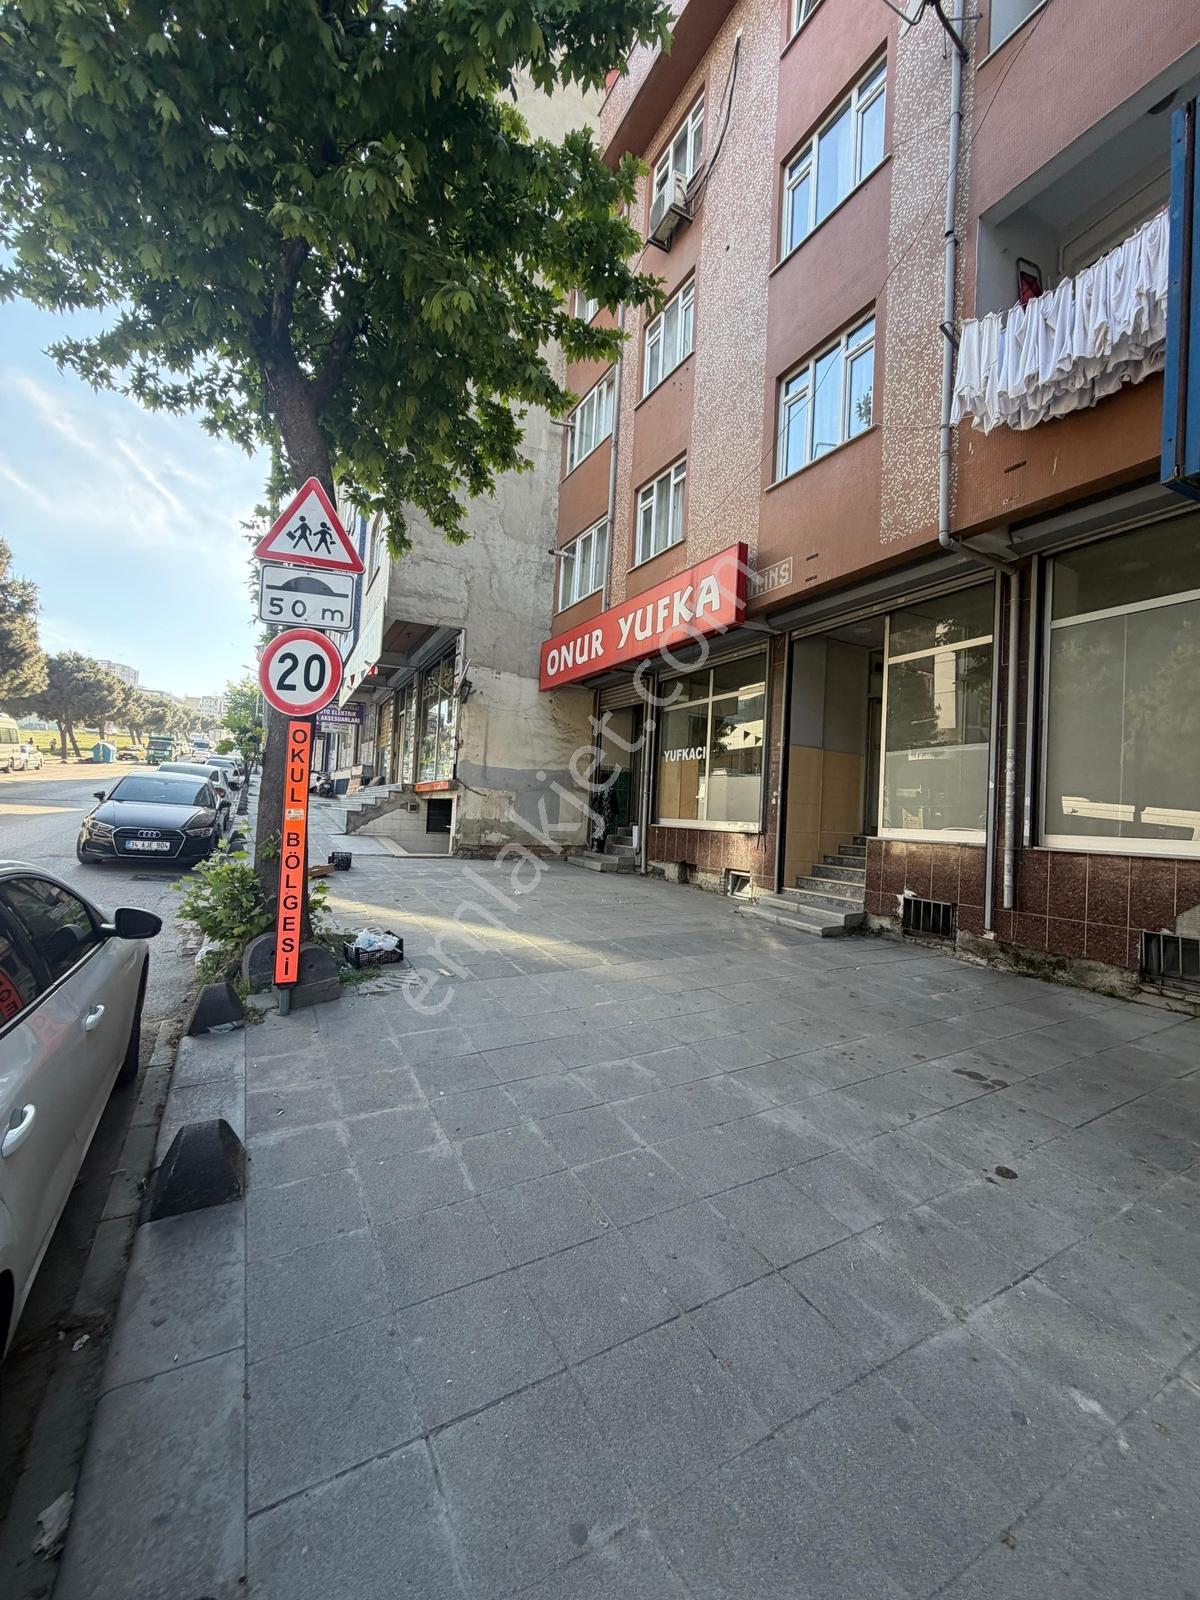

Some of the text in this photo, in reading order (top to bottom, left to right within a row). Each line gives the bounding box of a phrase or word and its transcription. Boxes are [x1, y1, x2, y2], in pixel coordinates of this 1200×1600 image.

[269, 597, 344, 622] 50 m
[546, 575, 720, 676] ONUR YUFKA
[276, 652, 326, 692] 20
[290, 728, 308, 803] OKUL
[664, 746, 706, 762] YUFKACI
[281, 831, 301, 977] BÖLGESİ
